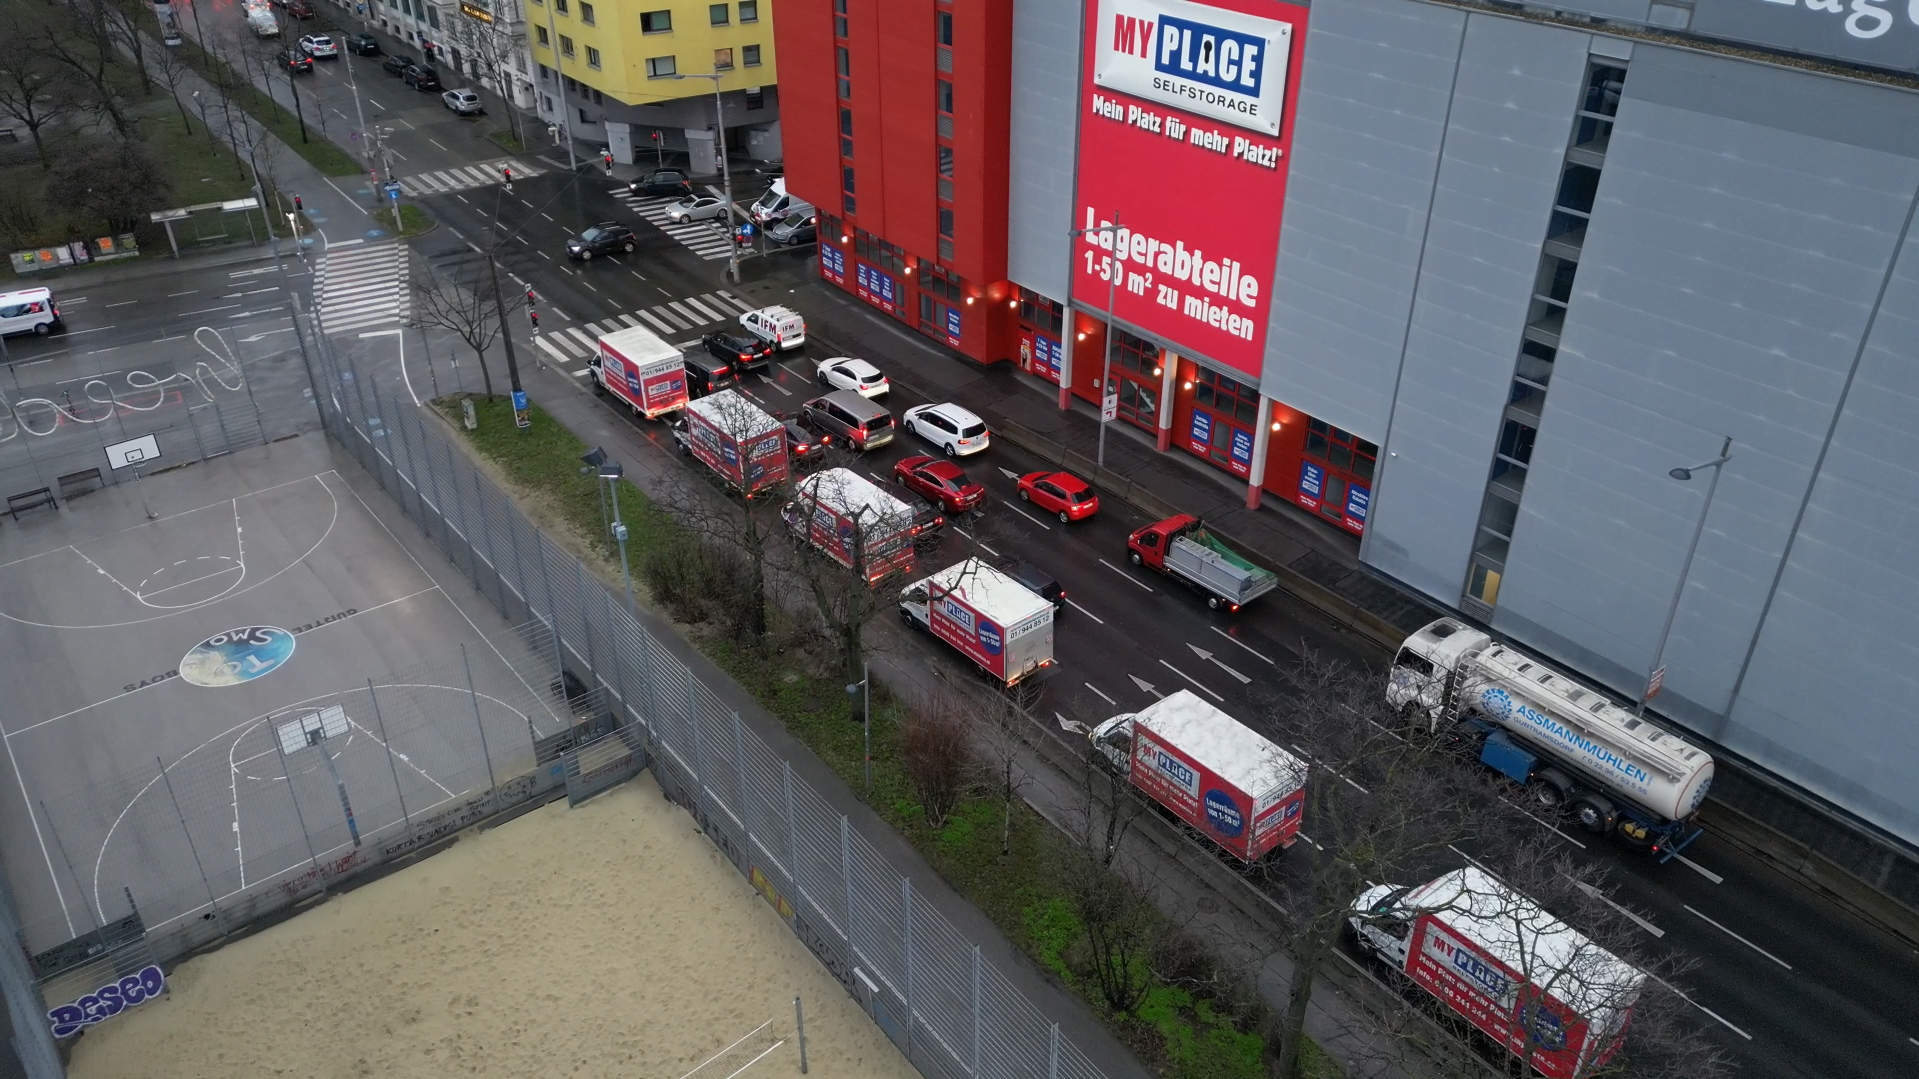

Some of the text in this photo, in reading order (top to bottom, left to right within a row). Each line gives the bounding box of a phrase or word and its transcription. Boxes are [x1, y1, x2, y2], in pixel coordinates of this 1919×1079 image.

[1113, 13, 1259, 88] MY PLACE
[1153, 76, 1258, 116] SELFSTORAGE
[1092, 93, 1124, 122] Mein
[1128, 104, 1162, 133] Platz
[1165, 116, 1187, 140] für
[1190, 127, 1230, 154] mehr
[1085, 206, 1259, 308] Lagerabteile
[1084, 249, 1123, 286] 1-50
[1156, 283, 1179, 310] zu
[1183, 294, 1254, 341] mieten
[760, 318, 777, 335] IFM
[782, 323, 795, 332] IFM
[948, 603, 970, 624] PLACE
[1042, 615, 1050, 623] 12
[122, 668, 178, 694] BOYS
[1513, 716, 1575, 754] GUNTRAMSDORF
[1516, 705, 1647, 783] ASSMANNMÜHLEN
[1142, 744, 1158, 760] MY
[1160, 754, 1192, 784] PLACE
[1206, 797, 1240, 819] Lagerräume
[1208, 808, 1218, 818] von
[1416, 966, 1433, 983] Info:
[1419, 954, 1437, 972] Mein
[1437, 967, 1456, 985] Platz
[1456, 980, 1468, 993] für
[1468, 989, 1489, 1007] mehr
[1433, 936, 1506, 995] MY PLACE
